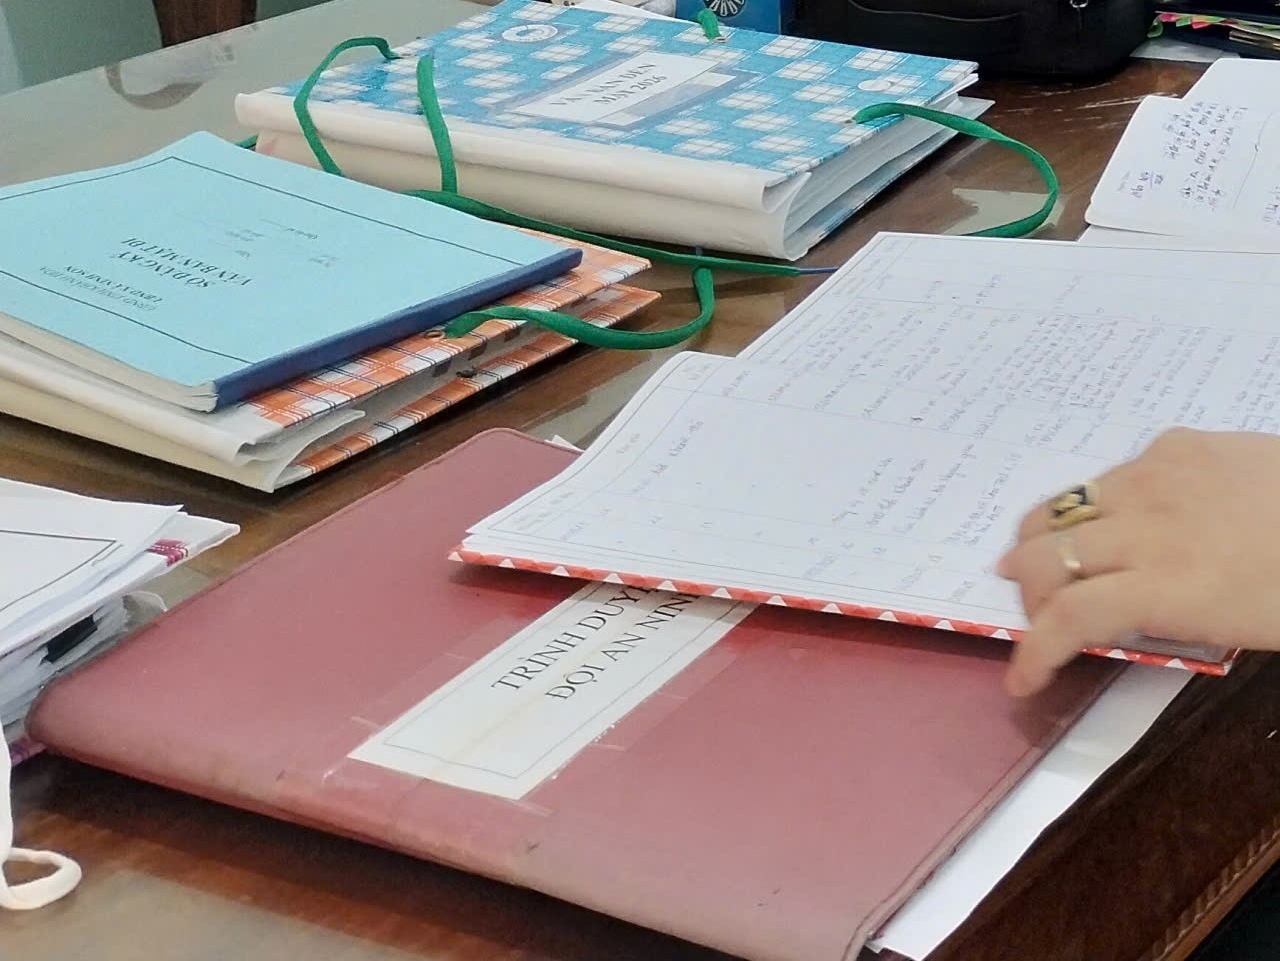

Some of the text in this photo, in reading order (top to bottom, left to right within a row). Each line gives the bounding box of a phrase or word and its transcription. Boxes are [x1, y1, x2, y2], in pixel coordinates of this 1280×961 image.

[629, 75, 668, 91] 2026
[218, 270, 252, 286] VĂN
[491, 632, 584, 692] TRÌNH
[544, 663, 605, 700] ĐỘI
[601, 632, 647, 662] AN
